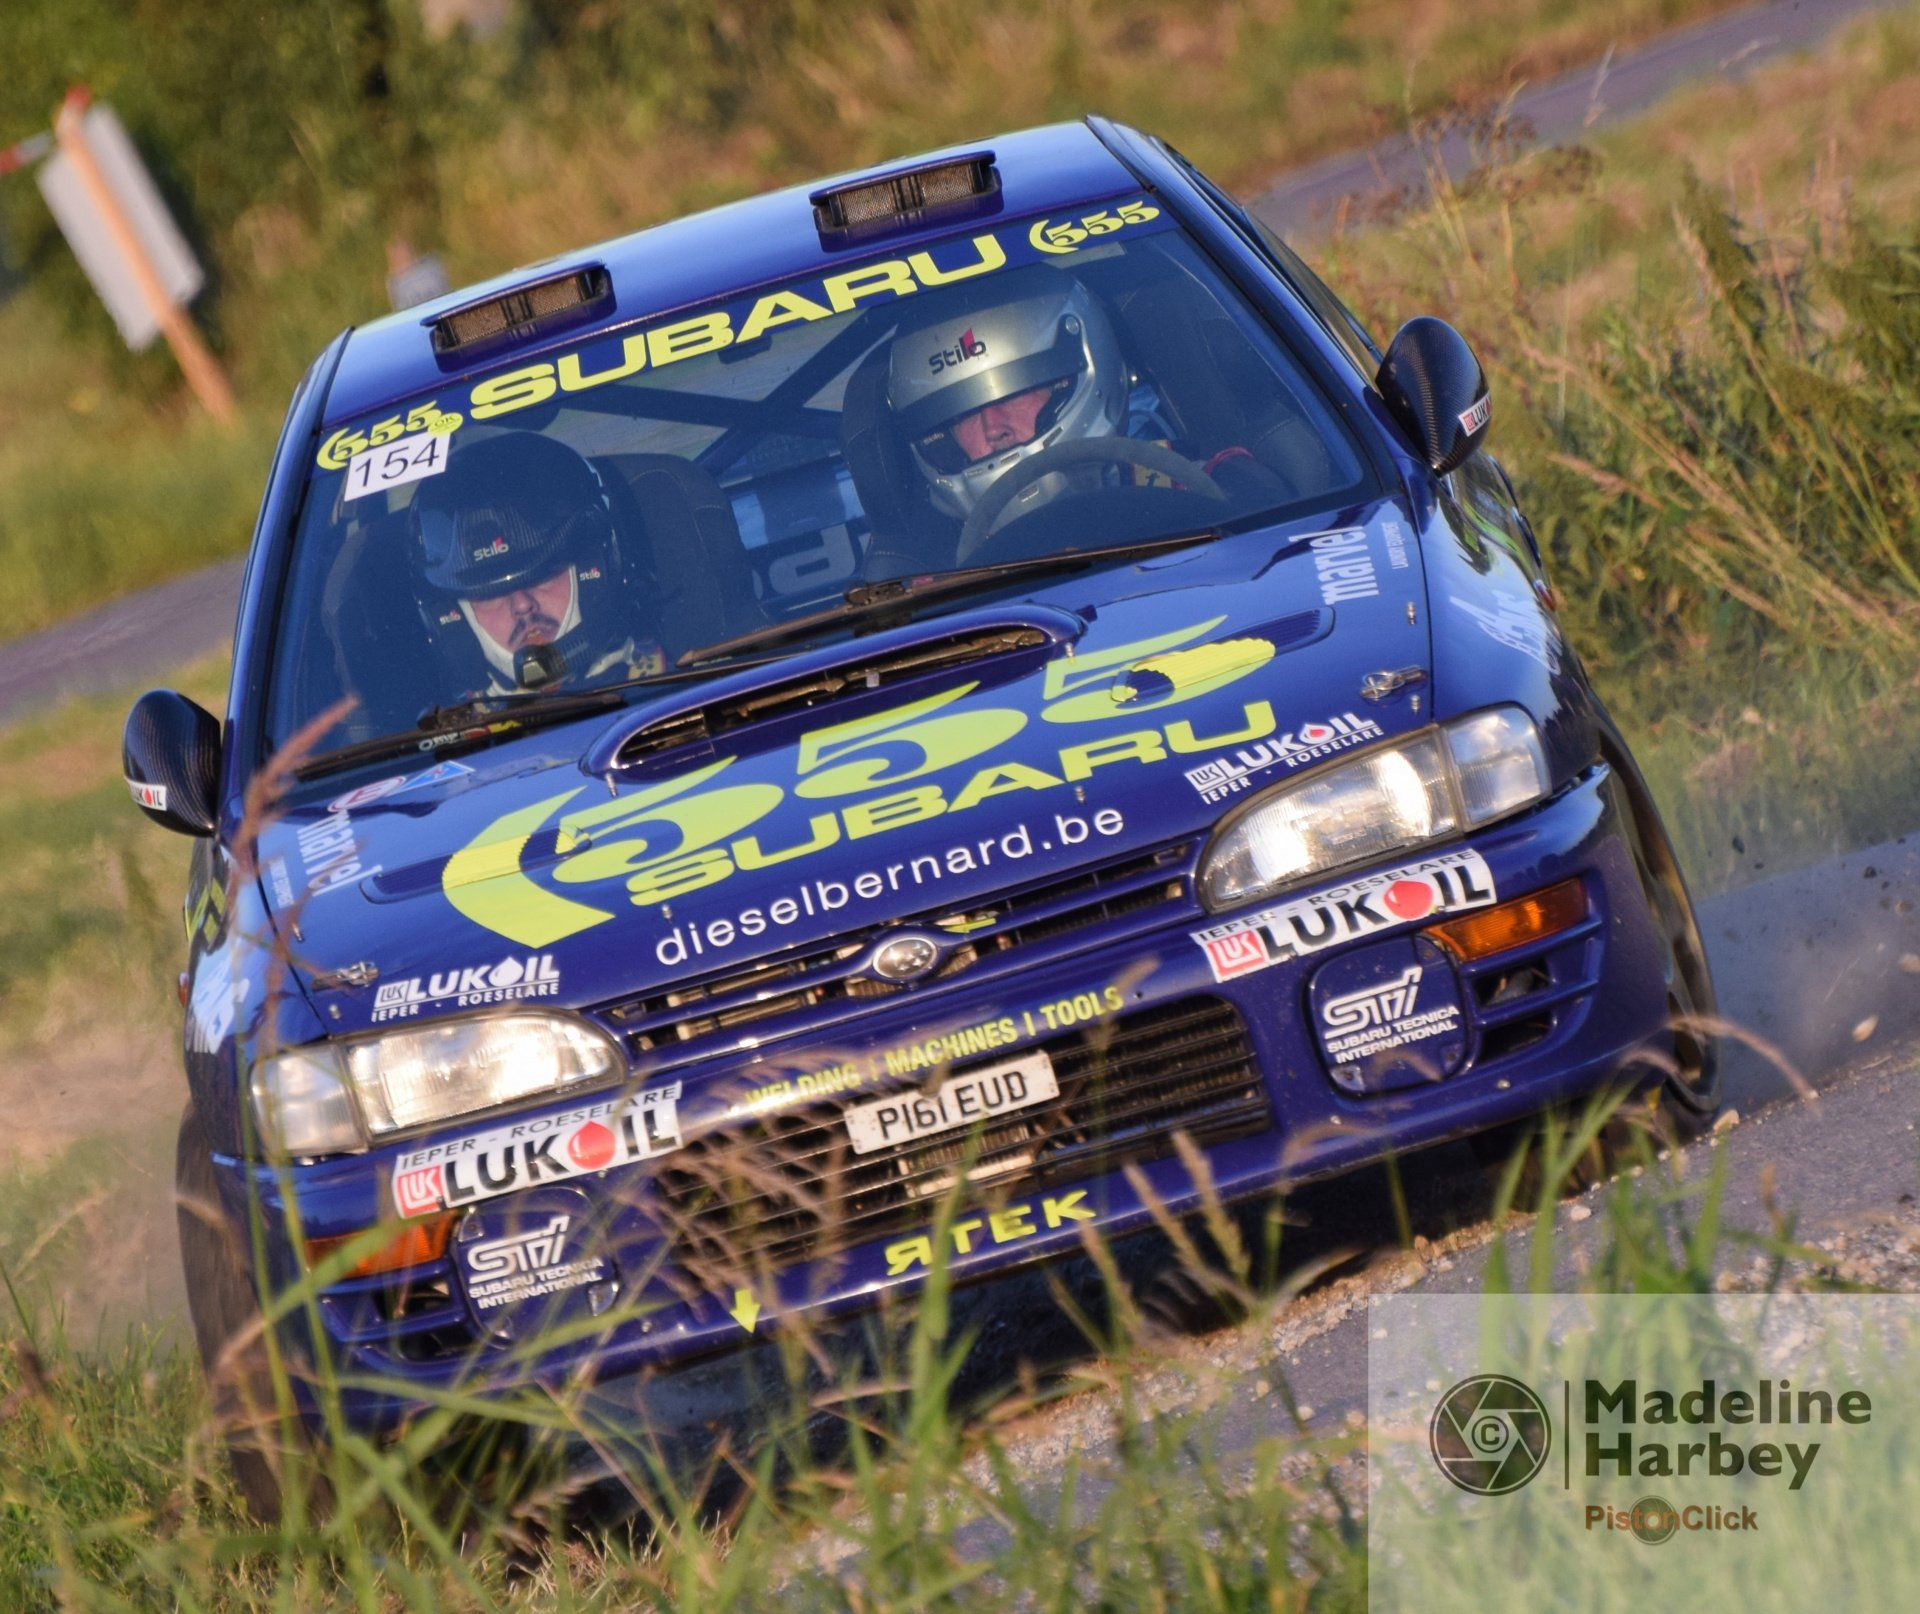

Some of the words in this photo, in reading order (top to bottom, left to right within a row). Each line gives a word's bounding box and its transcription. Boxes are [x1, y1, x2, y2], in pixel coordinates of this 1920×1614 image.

[469, 234, 1007, 420] SUBARU
[355, 437, 439, 487] 154
[1288, 526, 1379, 605] marvel
[1201, 776, 1252, 805] IEPER
[1286, 726, 1385, 768] ROESELARE
[629, 700, 1276, 907] SUBARU
[655, 808, 1125, 966] dieselbernard.be
[1200, 909, 1277, 942] IEPER
[1308, 849, 1476, 905] ROESELARE
[371, 1004, 419, 1023] IEPER
[457, 982, 560, 1007] ROESELARE
[884, 1018, 1019, 1077] MACHINES
[1039, 985, 1125, 1030] TOOLS
[1327, 1025, 1392, 1053] SUBARU
[1393, 1004, 1460, 1034] TECNICA
[1334, 1019, 1458, 1064] INTERNATIONAL
[877, 1096, 950, 1141] P161
[953, 1070, 1029, 1118] EUD
[402, 1138, 476, 1169] IEPER
[468, 1272, 536, 1299] SUBARU
[536, 1256, 605, 1282] TECNICA
[477, 1271, 603, 1310] INTERNATIONAL
